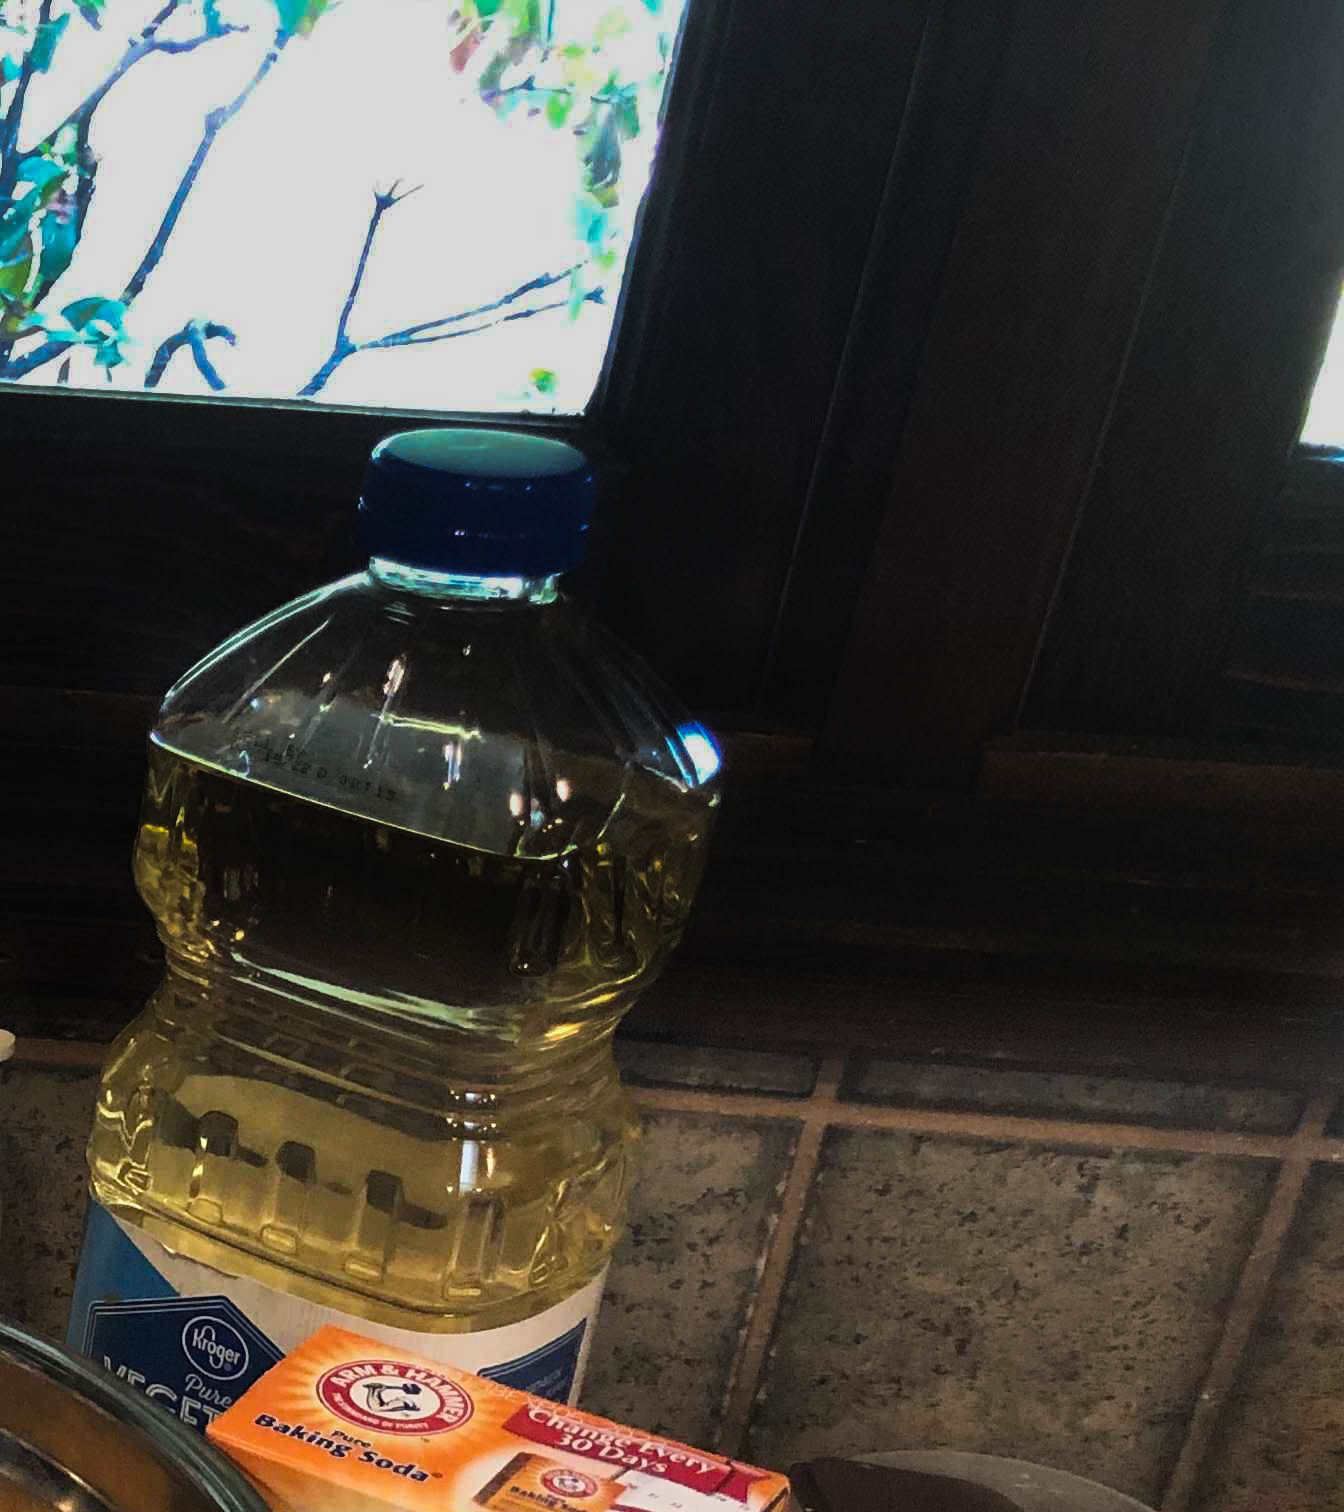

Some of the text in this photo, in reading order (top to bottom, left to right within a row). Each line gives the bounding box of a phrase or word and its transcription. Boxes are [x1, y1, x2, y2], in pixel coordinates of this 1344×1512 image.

[191, 1325, 241, 1370] Kroger
[185, 1373, 233, 1408] Pure
[329, 1363, 378, 1389] ARM
[380, 1363, 401, 1376] &
[405, 1367, 466, 1424] HAMMER
[253, 1413, 353, 1459] Baking
[357, 1450, 430, 1483] Soda
[331, 1428, 372, 1449] Pure
[527, 1404, 714, 1476] Change Every
[559, 1433, 669, 1474] 30 Days
